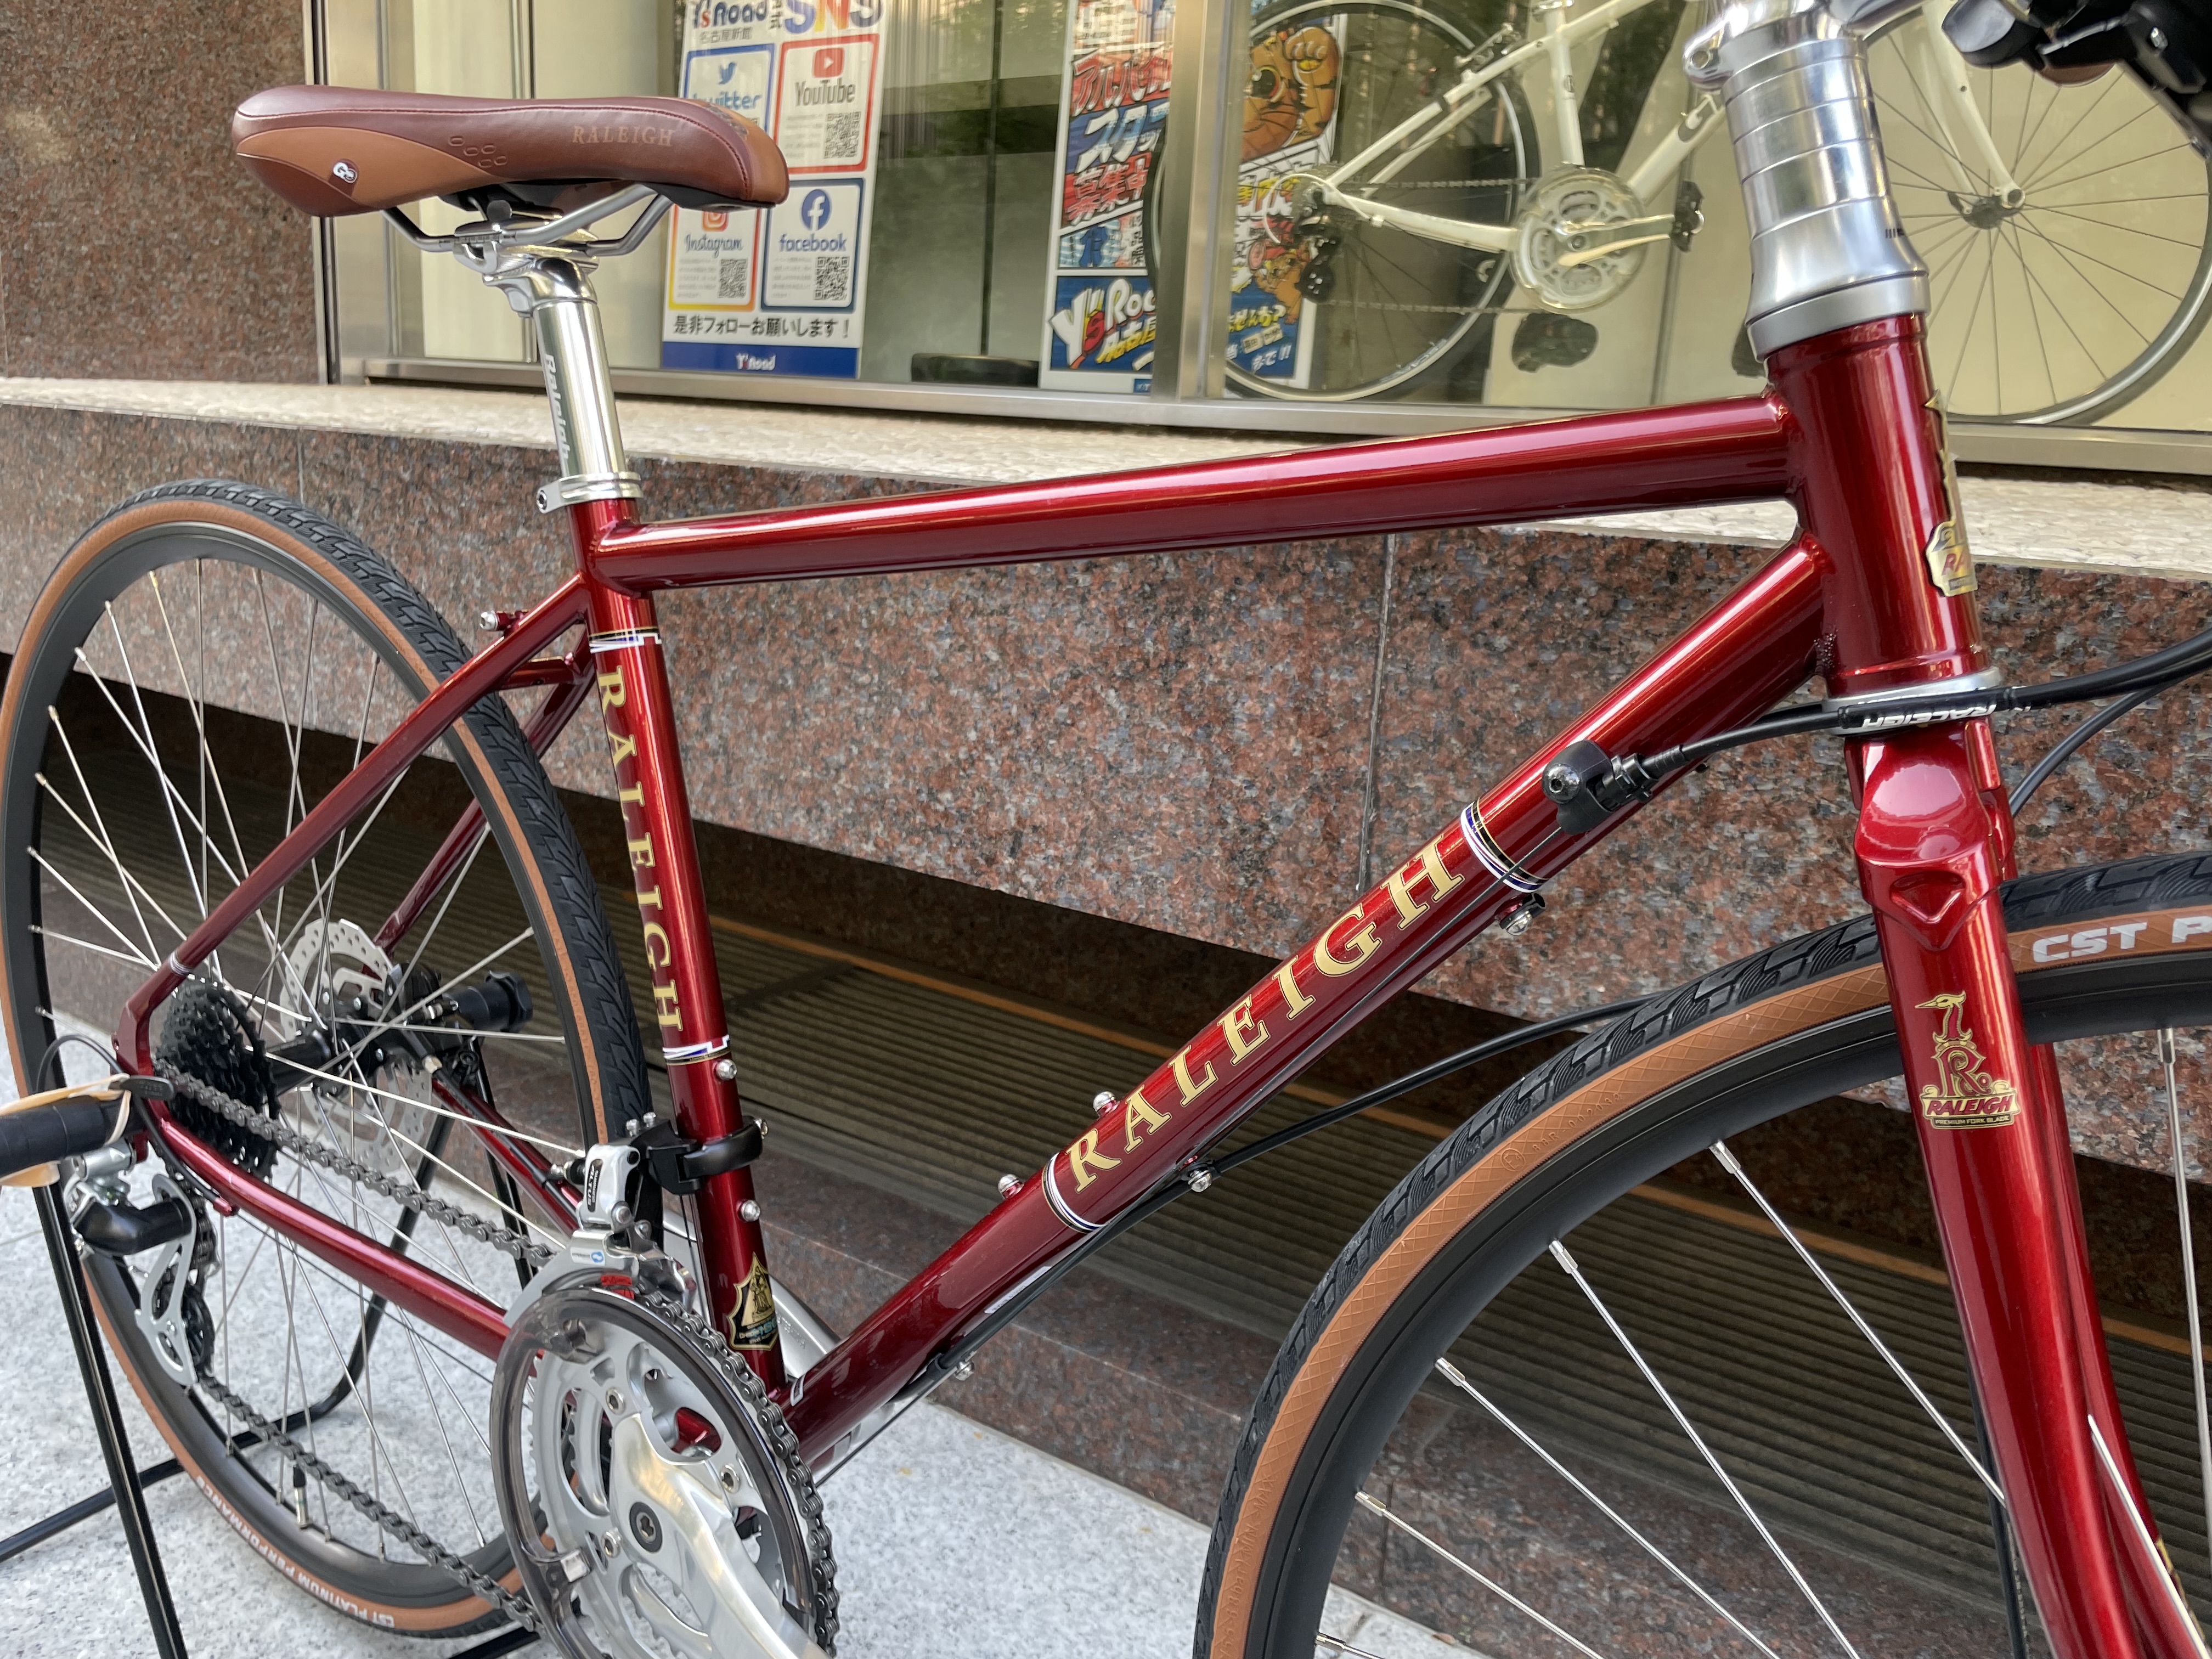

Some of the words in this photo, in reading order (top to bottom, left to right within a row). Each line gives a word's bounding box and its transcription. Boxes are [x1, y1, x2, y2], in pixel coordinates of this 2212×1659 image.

[693, 91, 762, 110] itter
[795, 78, 856, 106] YouTube
[572, 125, 675, 146] RALEIGH
[1065, 157, 1148, 225] 募集中
[684, 233, 743, 258] Instagram
[778, 233, 847, 252] facebook
[674, 314, 850, 338] 是非フォローお願いします！
[596, 665, 684, 1032] RALEIGH
[2033, 922, 2147, 962] CST
[1065, 833, 1464, 1192] RALEIGH
[1926, 1096, 2013, 1116] RALEIGH
[587, 1164, 595, 1206] ALTUS
[195, 1475, 295, 1578] PERFORMANCE
[297, 1571, 368, 1621] PLATINUM
